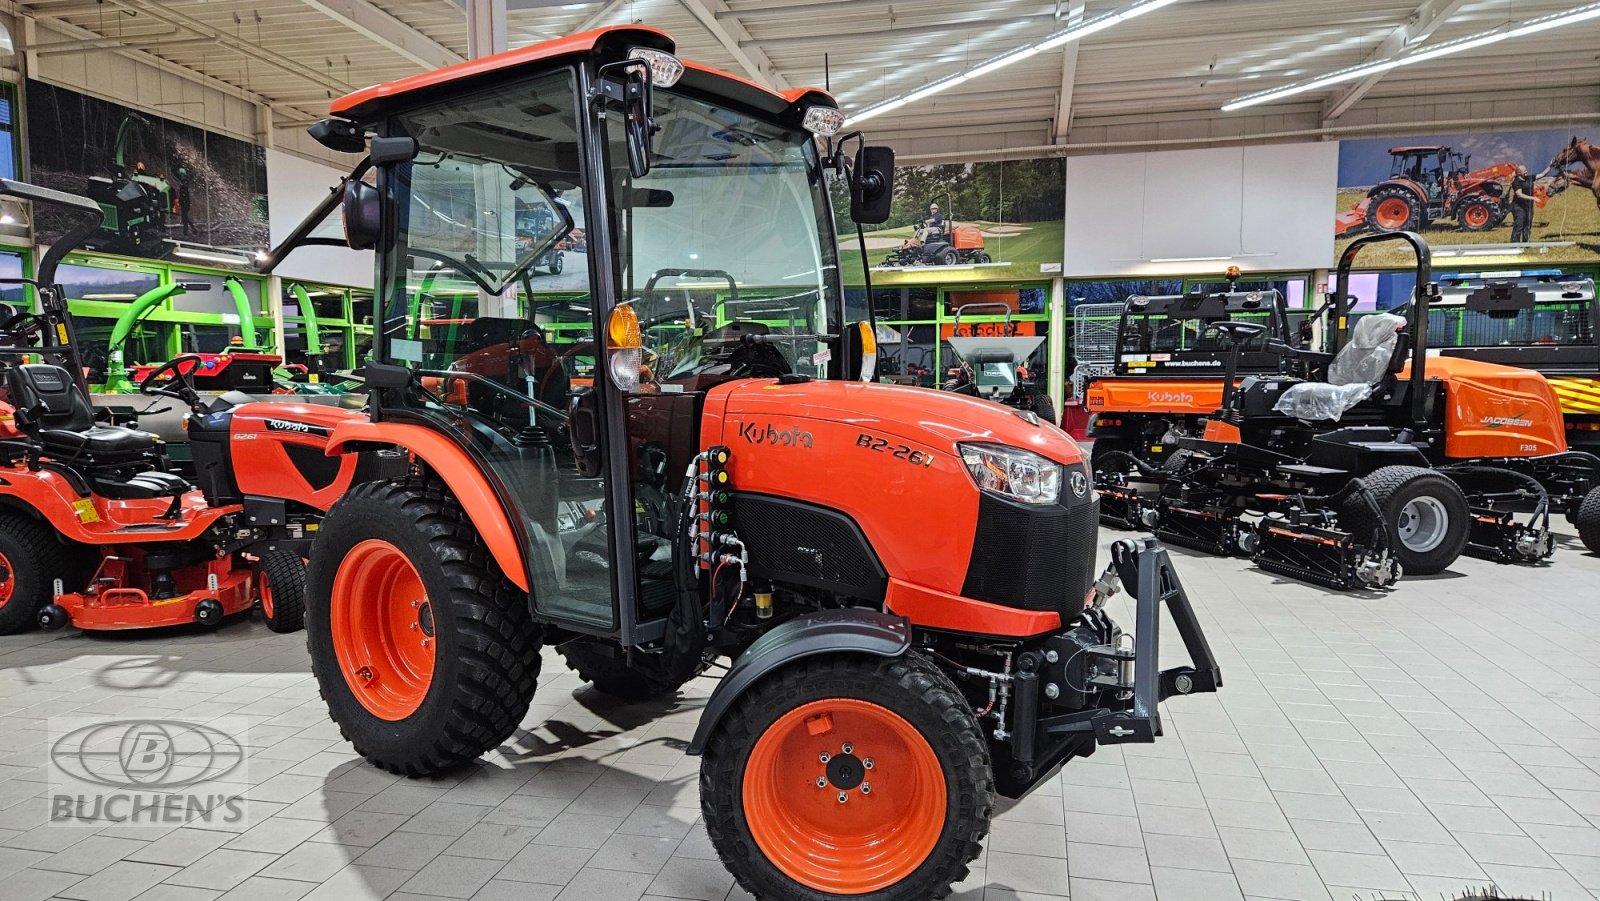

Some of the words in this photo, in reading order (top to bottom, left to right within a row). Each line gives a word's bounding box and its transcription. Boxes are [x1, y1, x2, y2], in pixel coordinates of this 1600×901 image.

[1148, 391, 1194, 403] Kubota
[270, 420, 308, 432] Kubota
[1480, 416, 1533, 427] JACOBSEN
[739, 421, 813, 448] Kubota
[856, 433, 935, 468] B2-261
